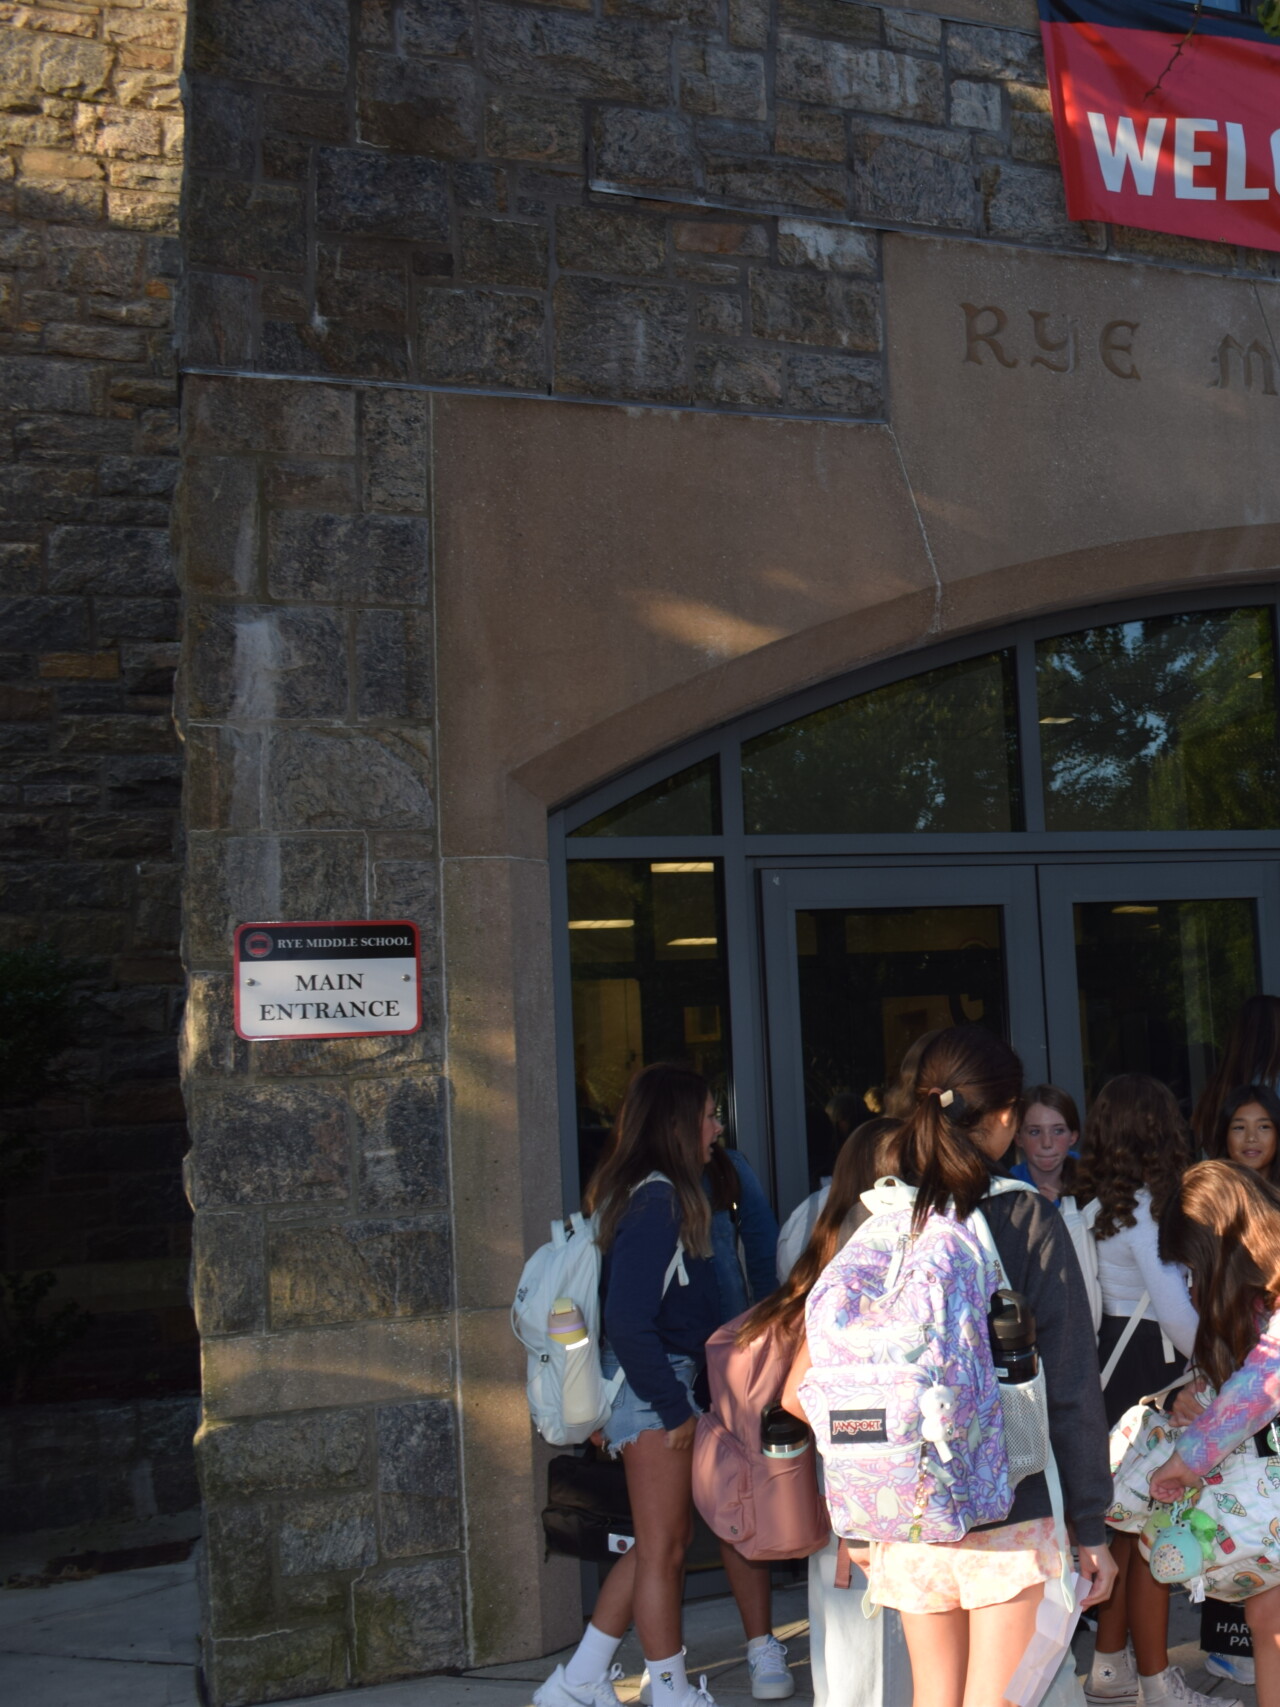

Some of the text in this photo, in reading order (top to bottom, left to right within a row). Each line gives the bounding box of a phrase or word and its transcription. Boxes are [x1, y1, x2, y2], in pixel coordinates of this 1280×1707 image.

[959, 301, 1142, 381] RYE
[277, 936, 412, 949] RYE MIDDLE SCHOOL
[295, 973, 364, 992] MAIN
[259, 1000, 400, 1021] ENTRANCE
[831, 1418, 883, 1436] JANSPORT
